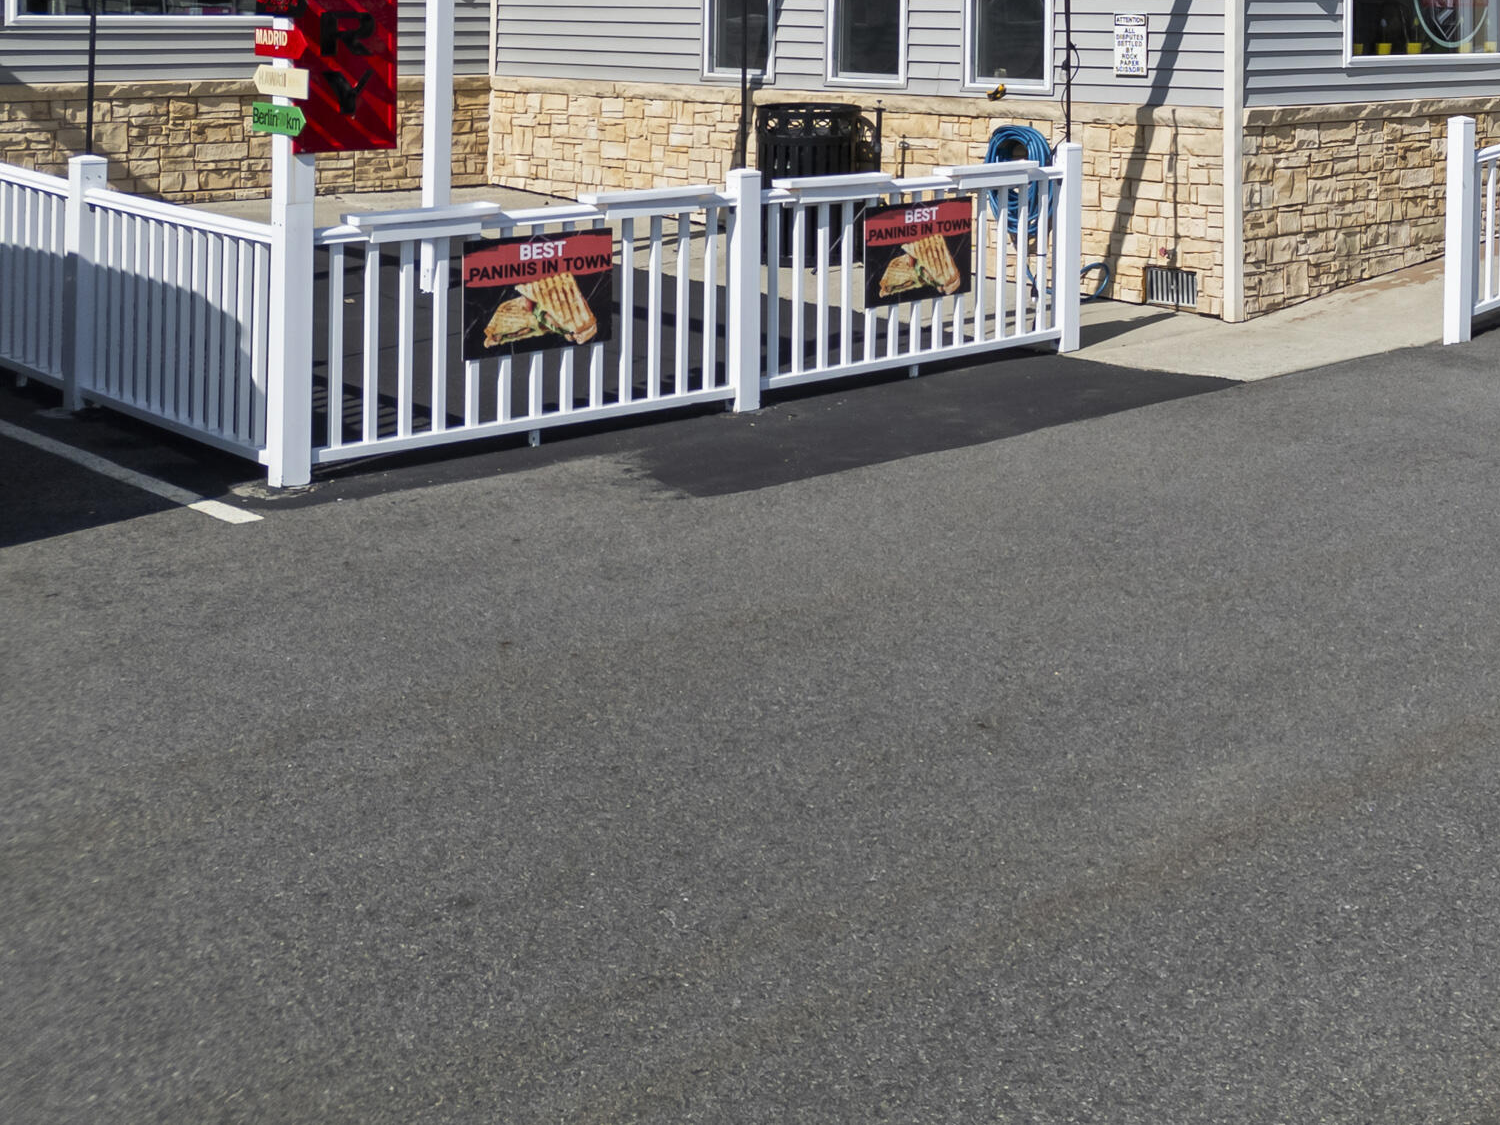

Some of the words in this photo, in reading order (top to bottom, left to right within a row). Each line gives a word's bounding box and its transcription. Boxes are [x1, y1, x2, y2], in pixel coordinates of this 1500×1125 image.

[1116, 16, 1144, 24] ATTENTION
[255, 28, 288, 47] MADRID
[253, 107, 278, 127] Berlin
[286, 112, 300, 131] km
[904, 206, 939, 224] BEST
[867, 225, 918, 242] PANINIS
[920, 223, 933, 235] IN
[935, 218, 972, 233] TOWN
[519, 240, 567, 261] BEST
[468, 261, 537, 282] PANINIS
[541, 259, 559, 274] IN
[562, 253, 612, 272] TOWN
